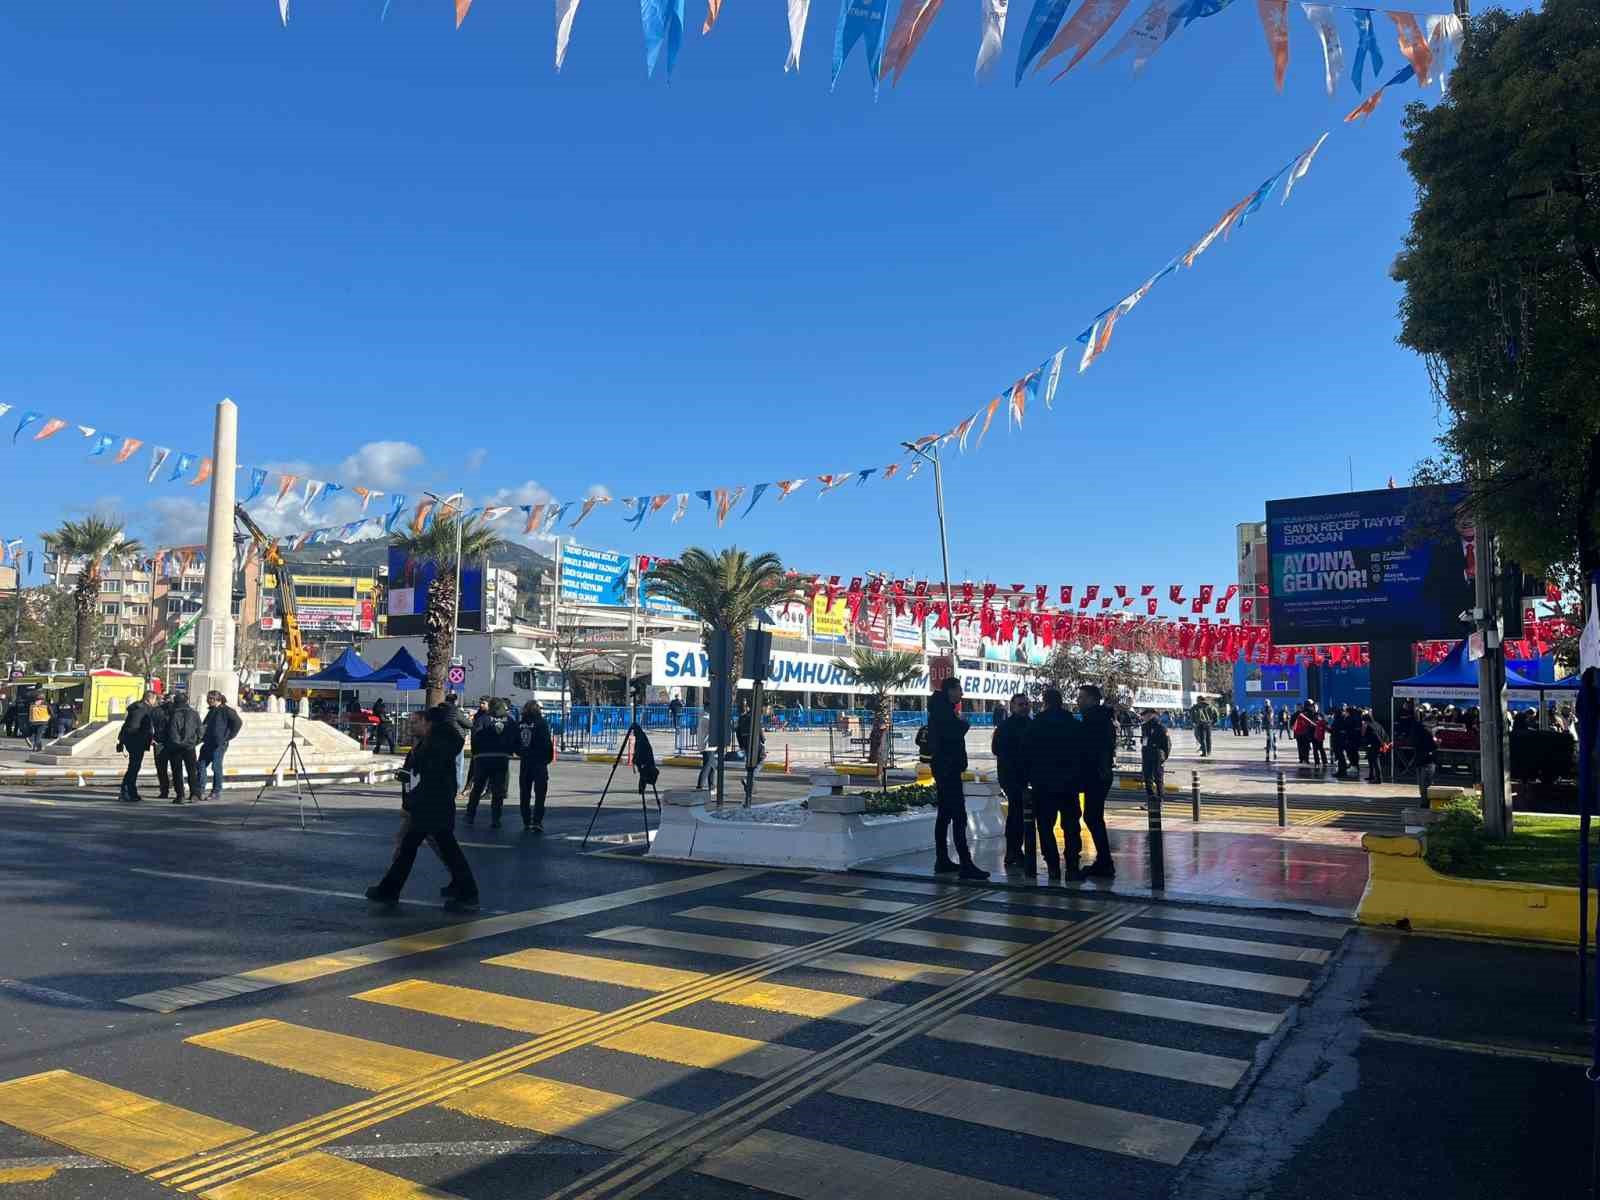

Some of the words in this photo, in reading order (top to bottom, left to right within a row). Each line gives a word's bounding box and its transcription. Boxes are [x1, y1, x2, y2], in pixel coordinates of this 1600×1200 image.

[1283, 522, 1318, 535] SAYIN
[1320, 519, 1360, 531] RECEP
[1283, 550, 1356, 574] AYDIN'A
[664, 651, 711, 678] SAY
